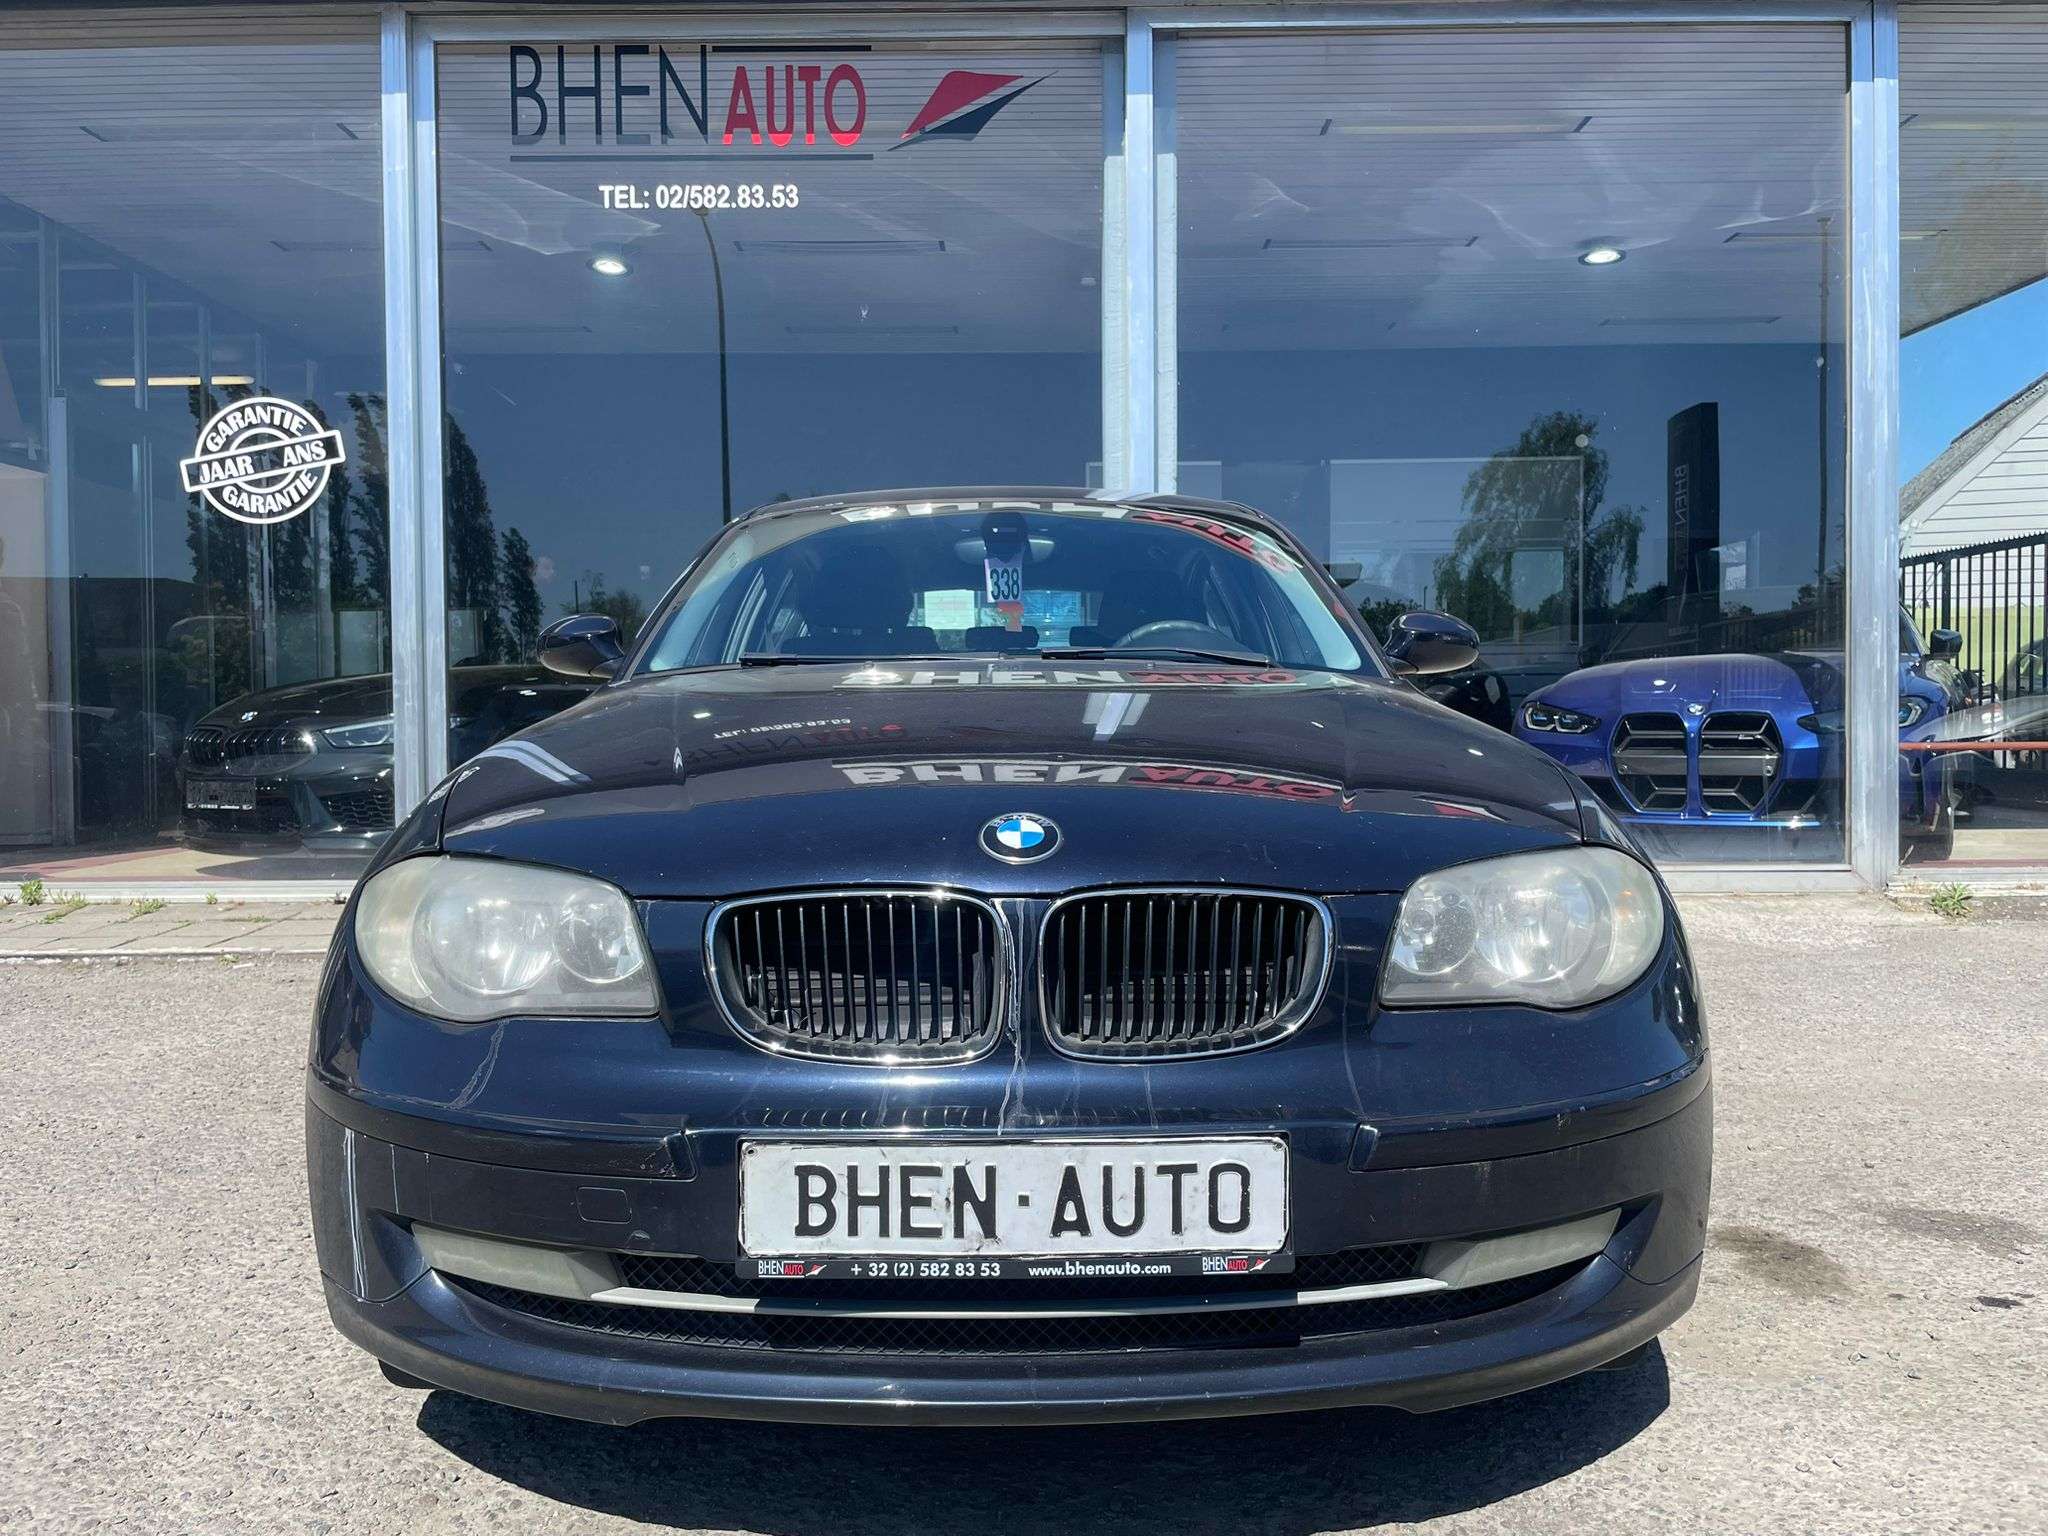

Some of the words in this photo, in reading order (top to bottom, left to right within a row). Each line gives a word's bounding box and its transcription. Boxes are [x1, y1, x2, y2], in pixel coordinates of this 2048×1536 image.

[510, 45, 708, 145] BHEN
[722, 64, 867, 147] AUTO
[598, 184, 650, 209] TEL:
[655, 184, 799, 209] 02/582.83.53
[205, 405, 307, 452] GARANTIE
[200, 455, 255, 484] JAAR
[283, 440, 327, 467] ANS
[222, 470, 318, 514] GARANTIE
[990, 567, 1020, 601] 338
[794, 1162, 1000, 1240] BHEN
[1049, 1161, 1252, 1239] AUTO
[868, 1263, 888, 1276] 32
[894, 1263, 914, 1277] (2)
[920, 1263, 950, 1276] 582
[955, 1263, 975, 1276] 83
[980, 1263, 1000, 1276] 53
[1028, 1261, 1172, 1276] www.bhenauto.com
